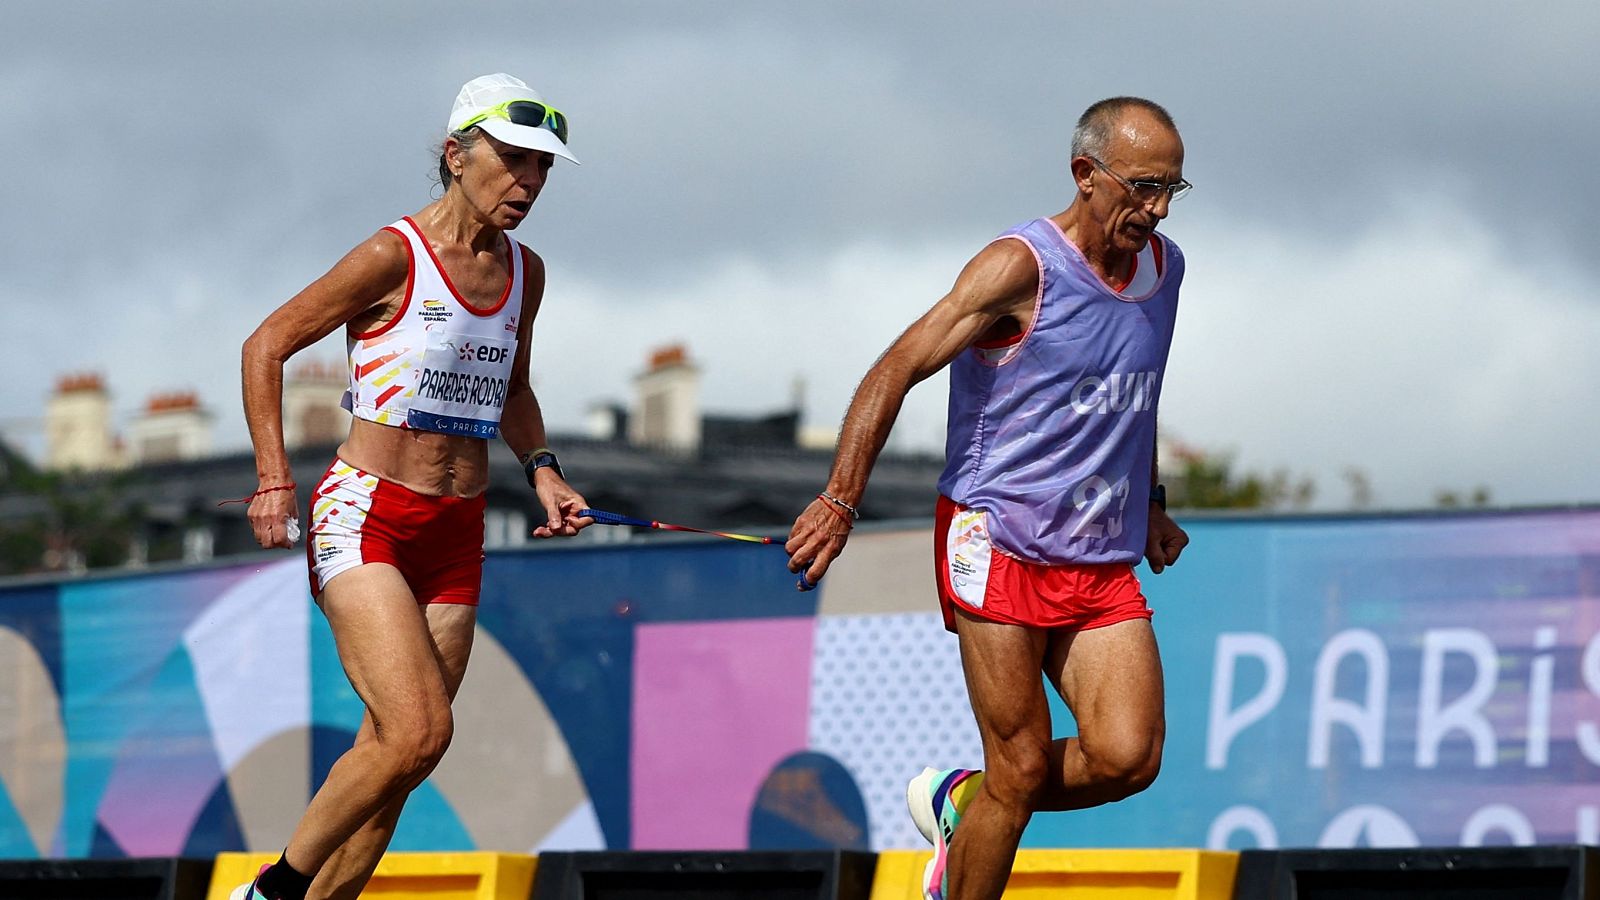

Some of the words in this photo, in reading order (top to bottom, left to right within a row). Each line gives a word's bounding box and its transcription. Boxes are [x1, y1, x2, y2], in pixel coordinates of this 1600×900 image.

[417, 368, 471, 403] PAREDES
[453, 421, 479, 433] PARIS
[481, 425, 498, 436] 20
[1069, 474, 1130, 539] 23
